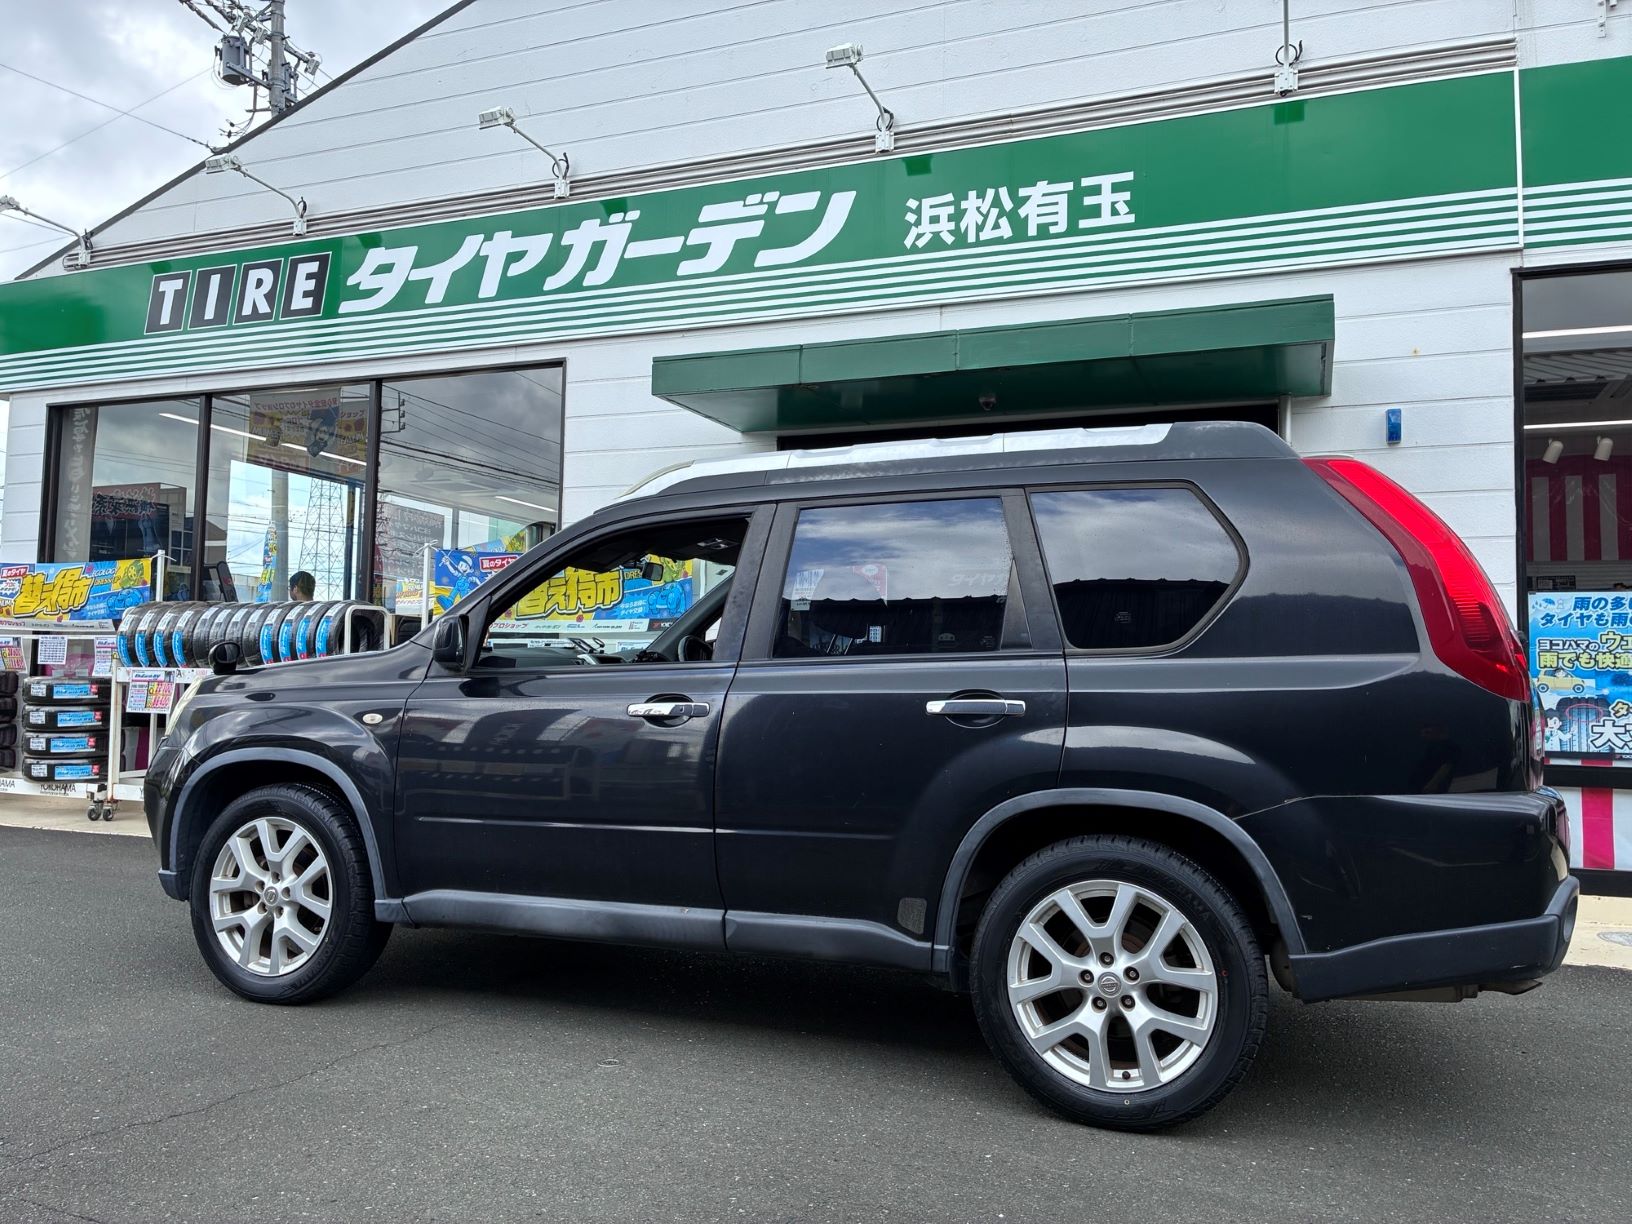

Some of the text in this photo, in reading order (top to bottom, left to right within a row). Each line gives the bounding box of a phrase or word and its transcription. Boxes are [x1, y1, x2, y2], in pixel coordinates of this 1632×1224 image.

[158, 260, 320, 325] TIRE
[338, 171, 1136, 313] タイヤガーデン 浜松有玉
